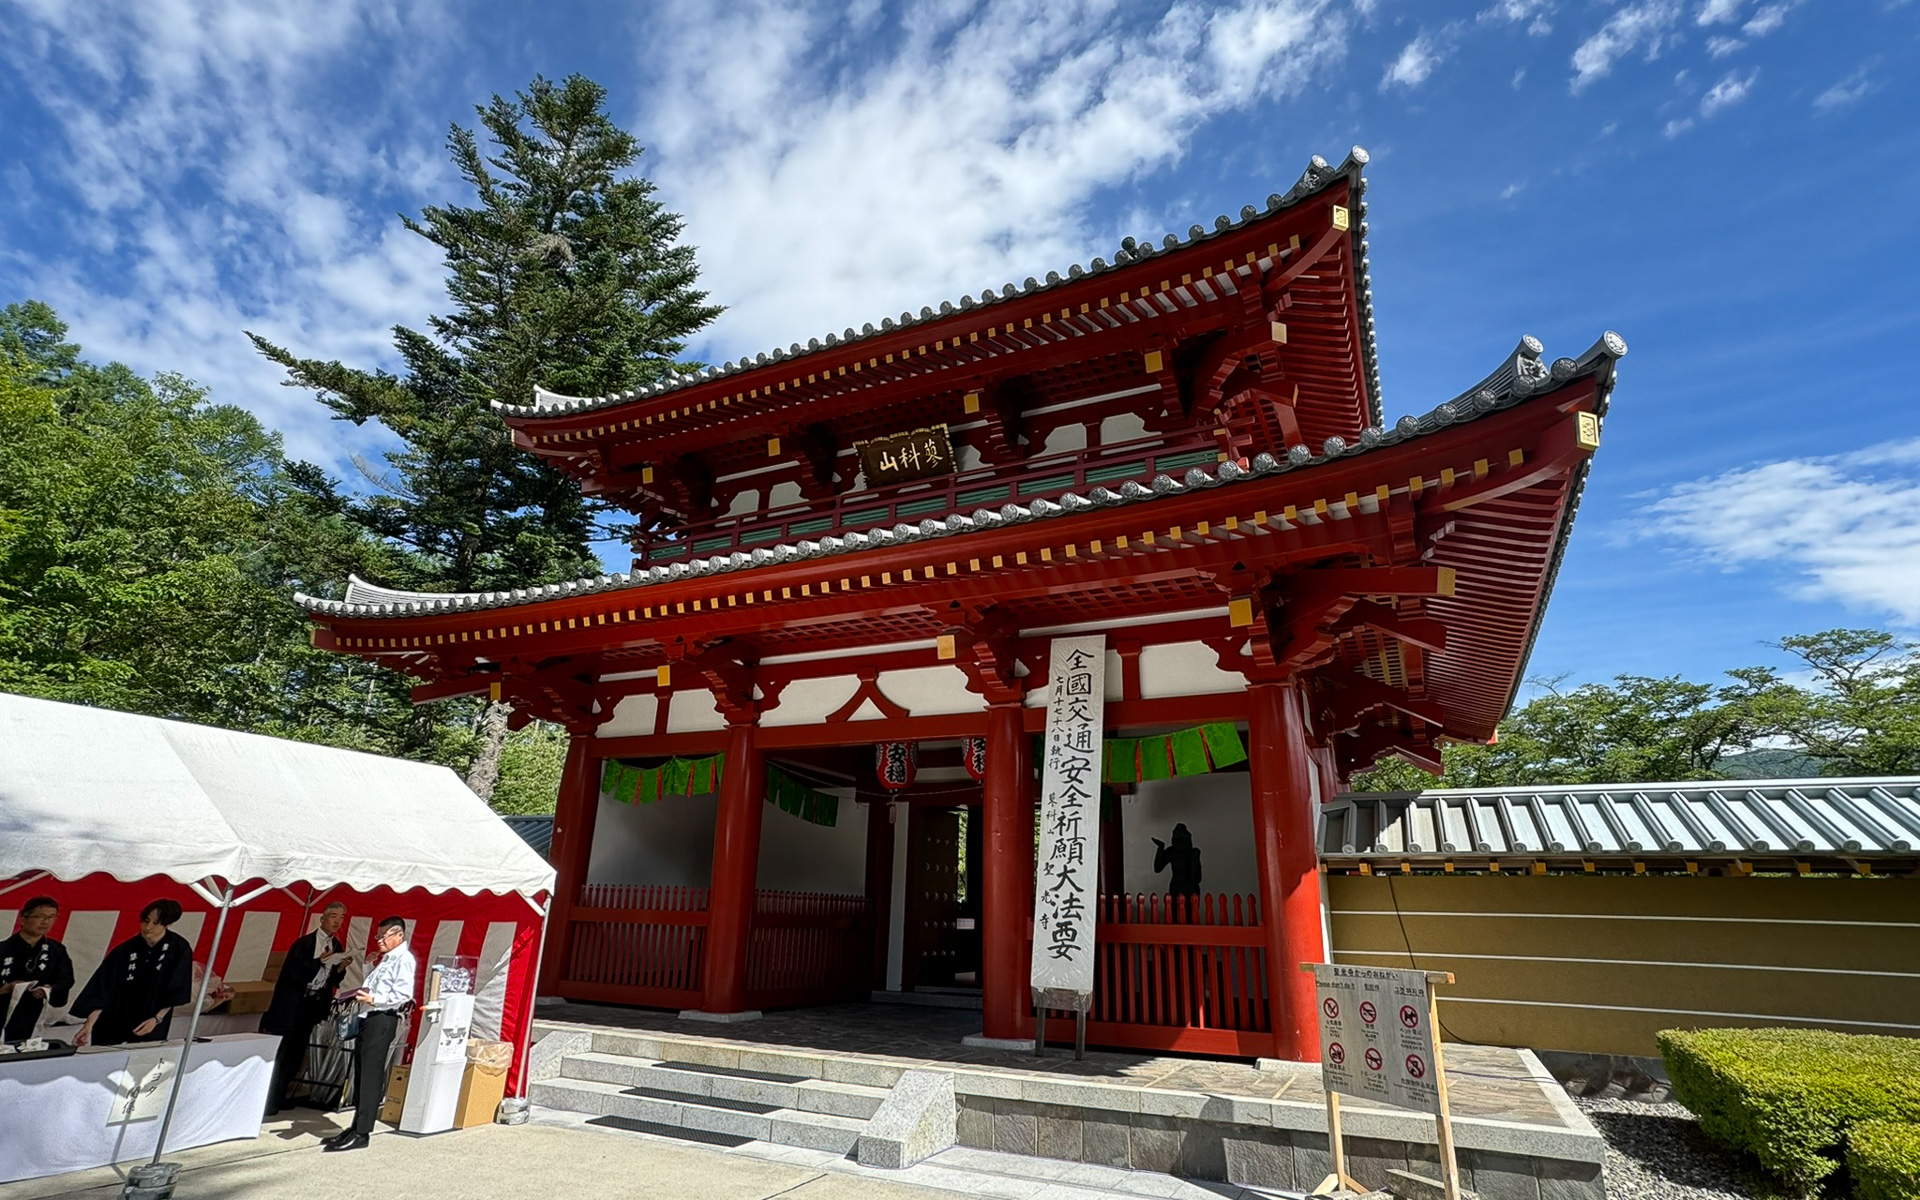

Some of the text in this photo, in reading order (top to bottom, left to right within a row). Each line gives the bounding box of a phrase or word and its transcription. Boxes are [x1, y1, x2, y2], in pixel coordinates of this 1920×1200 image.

[1047, 648, 1095, 962] 全國交通安全祈願大法要
